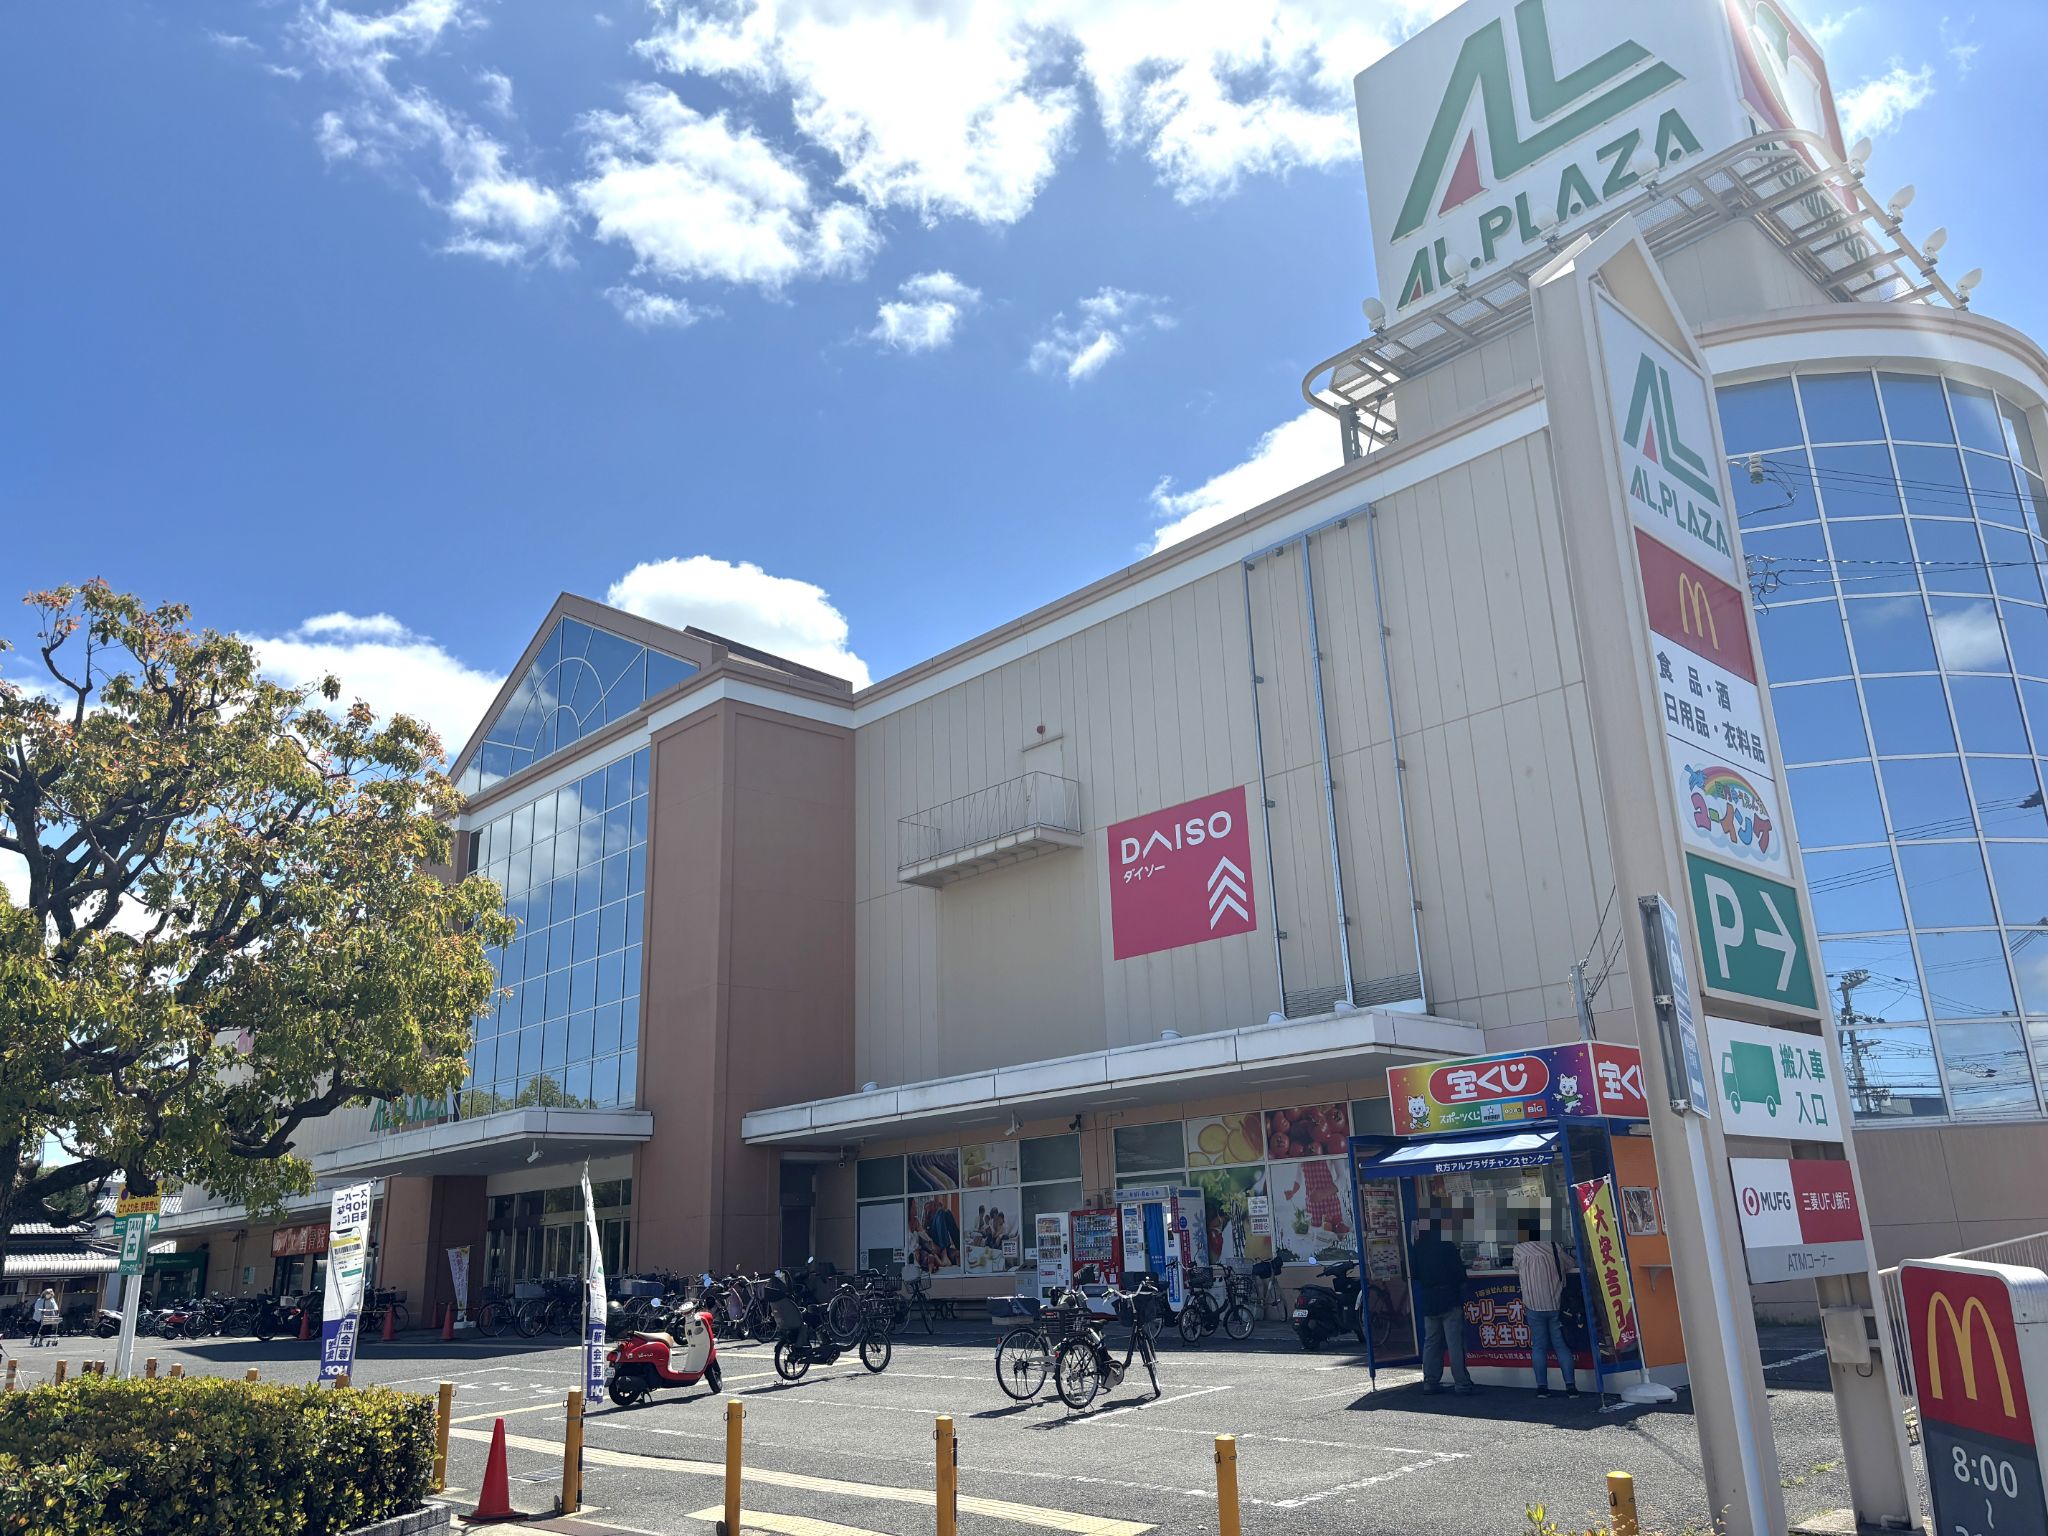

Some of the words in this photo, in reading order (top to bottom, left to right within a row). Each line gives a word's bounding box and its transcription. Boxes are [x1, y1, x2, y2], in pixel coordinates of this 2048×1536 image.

[1630, 464, 1732, 559] AL.PLAZA
[1663, 692, 1766, 764] 日用品・衣料品
[1121, 810, 1232, 865] DAISO
[1124, 864, 1166, 884] ダイソー
[1704, 873, 1745, 980] P
[1447, 1062, 1529, 1101] 宝くじ
[1779, 1043, 1826, 1083] 搬入車
[1439, 1110, 1481, 1125] スポーツくじ
[1796, 1091, 1829, 1127] 入口
[1435, 1154, 1553, 1173] 枚方アルプラザチャンスセンター
[1759, 1191, 1792, 1211] MUFG
[1802, 1191, 1851, 1211] 三菱UFJ銀行
[1593, 1203, 1627, 1330] 大安吉日
[1787, 1250, 1835, 1272] ATMコーナー
[1481, 1323, 1532, 1347] 発生中
[1951, 1446, 2018, 1498] 8:00
